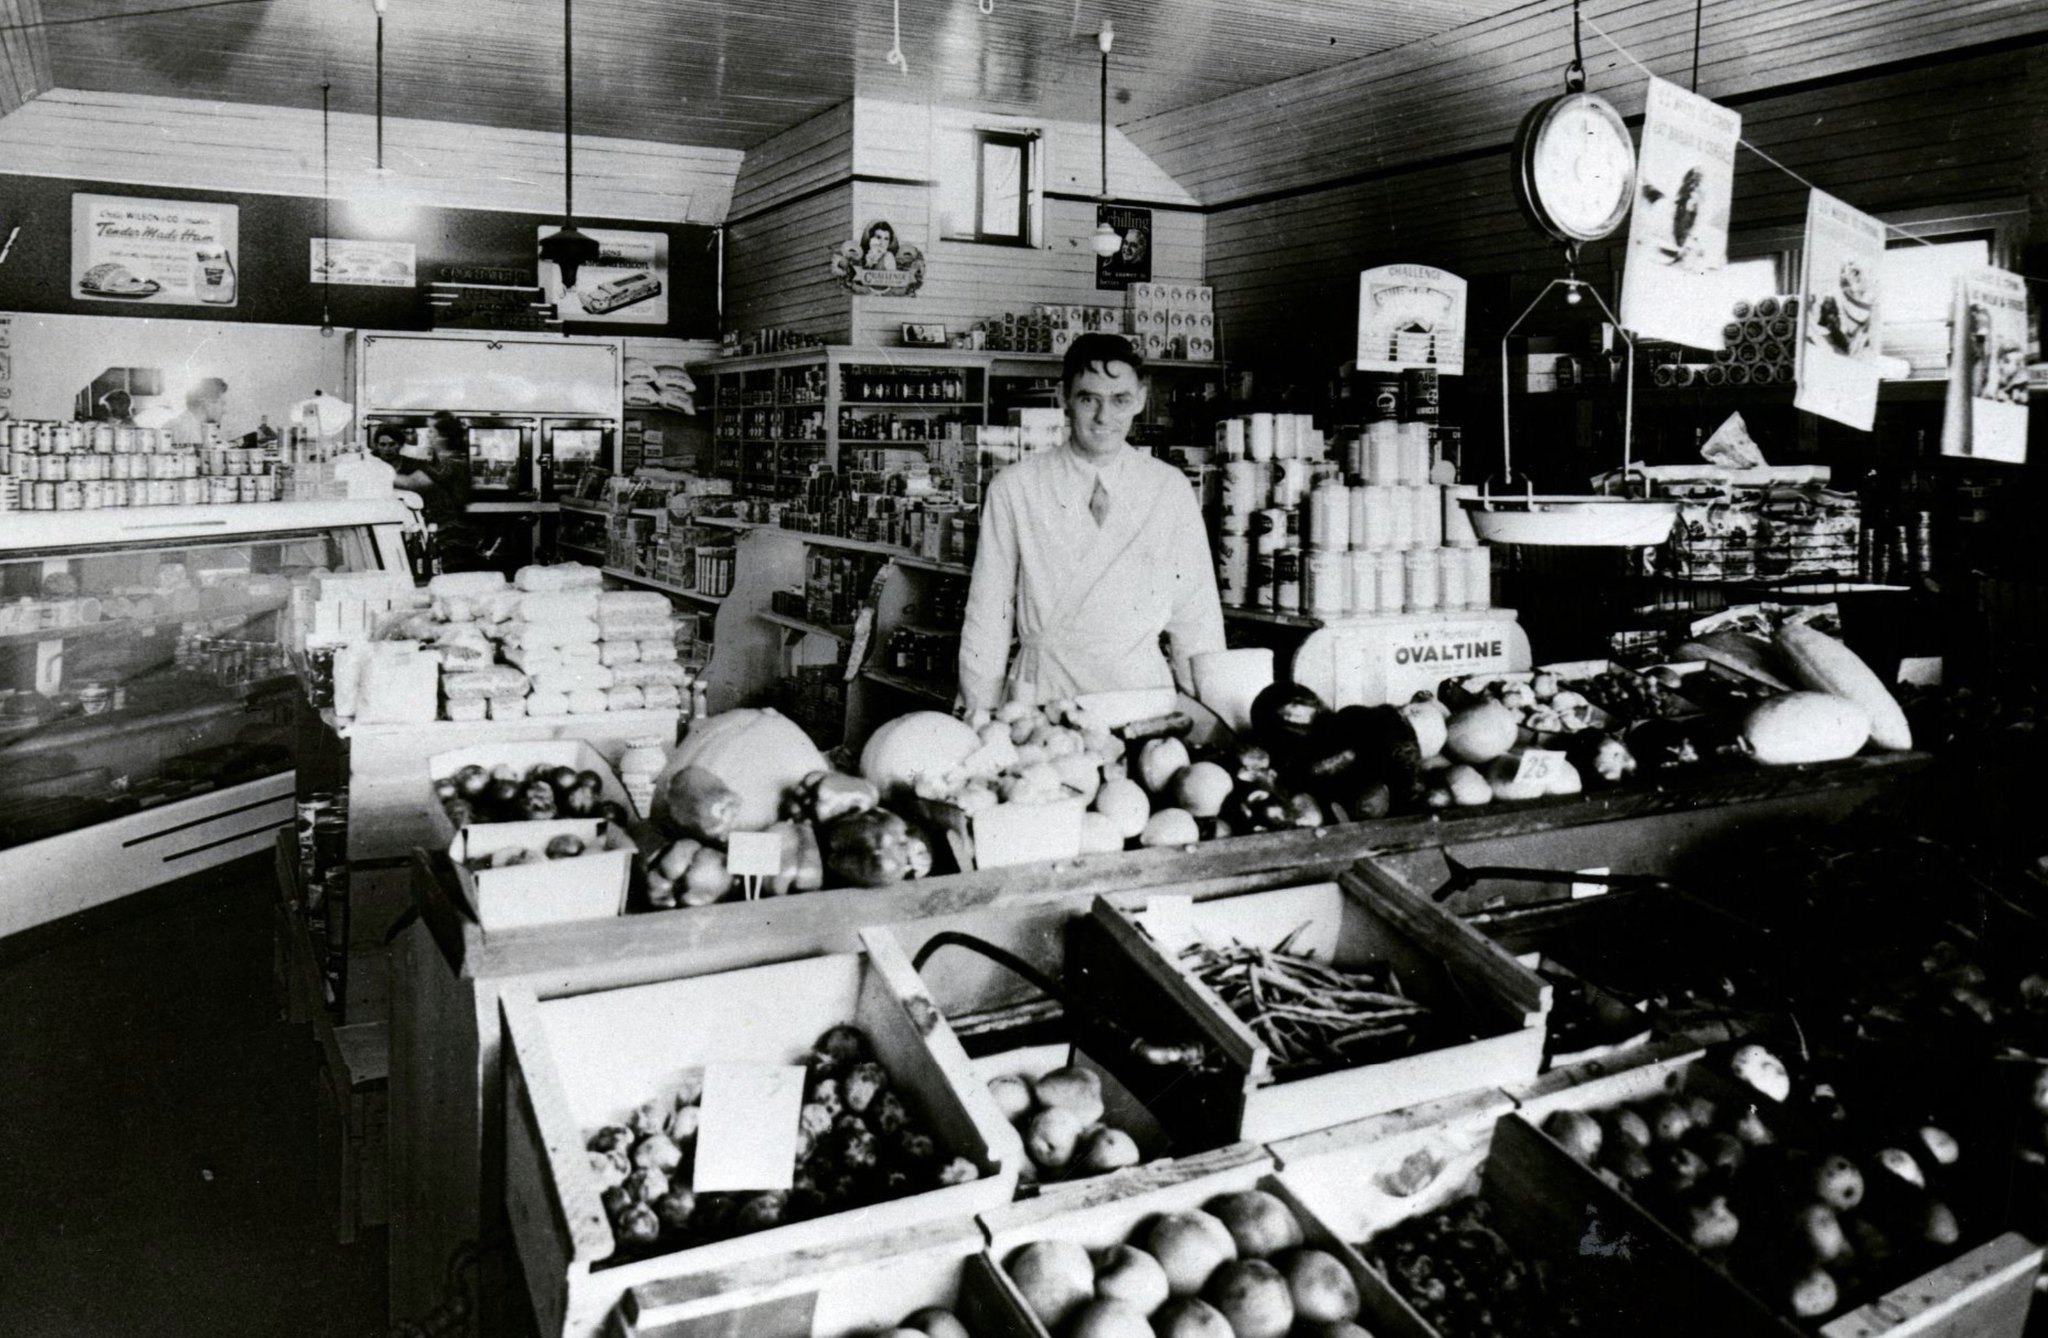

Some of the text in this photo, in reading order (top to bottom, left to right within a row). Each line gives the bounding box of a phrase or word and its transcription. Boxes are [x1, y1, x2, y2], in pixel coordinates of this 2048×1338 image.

[96, 221, 215, 243] Tender Made Ham
[1387, 265, 1442, 281] CHALLENGE
[1395, 640, 1502, 665] OVALTINE
